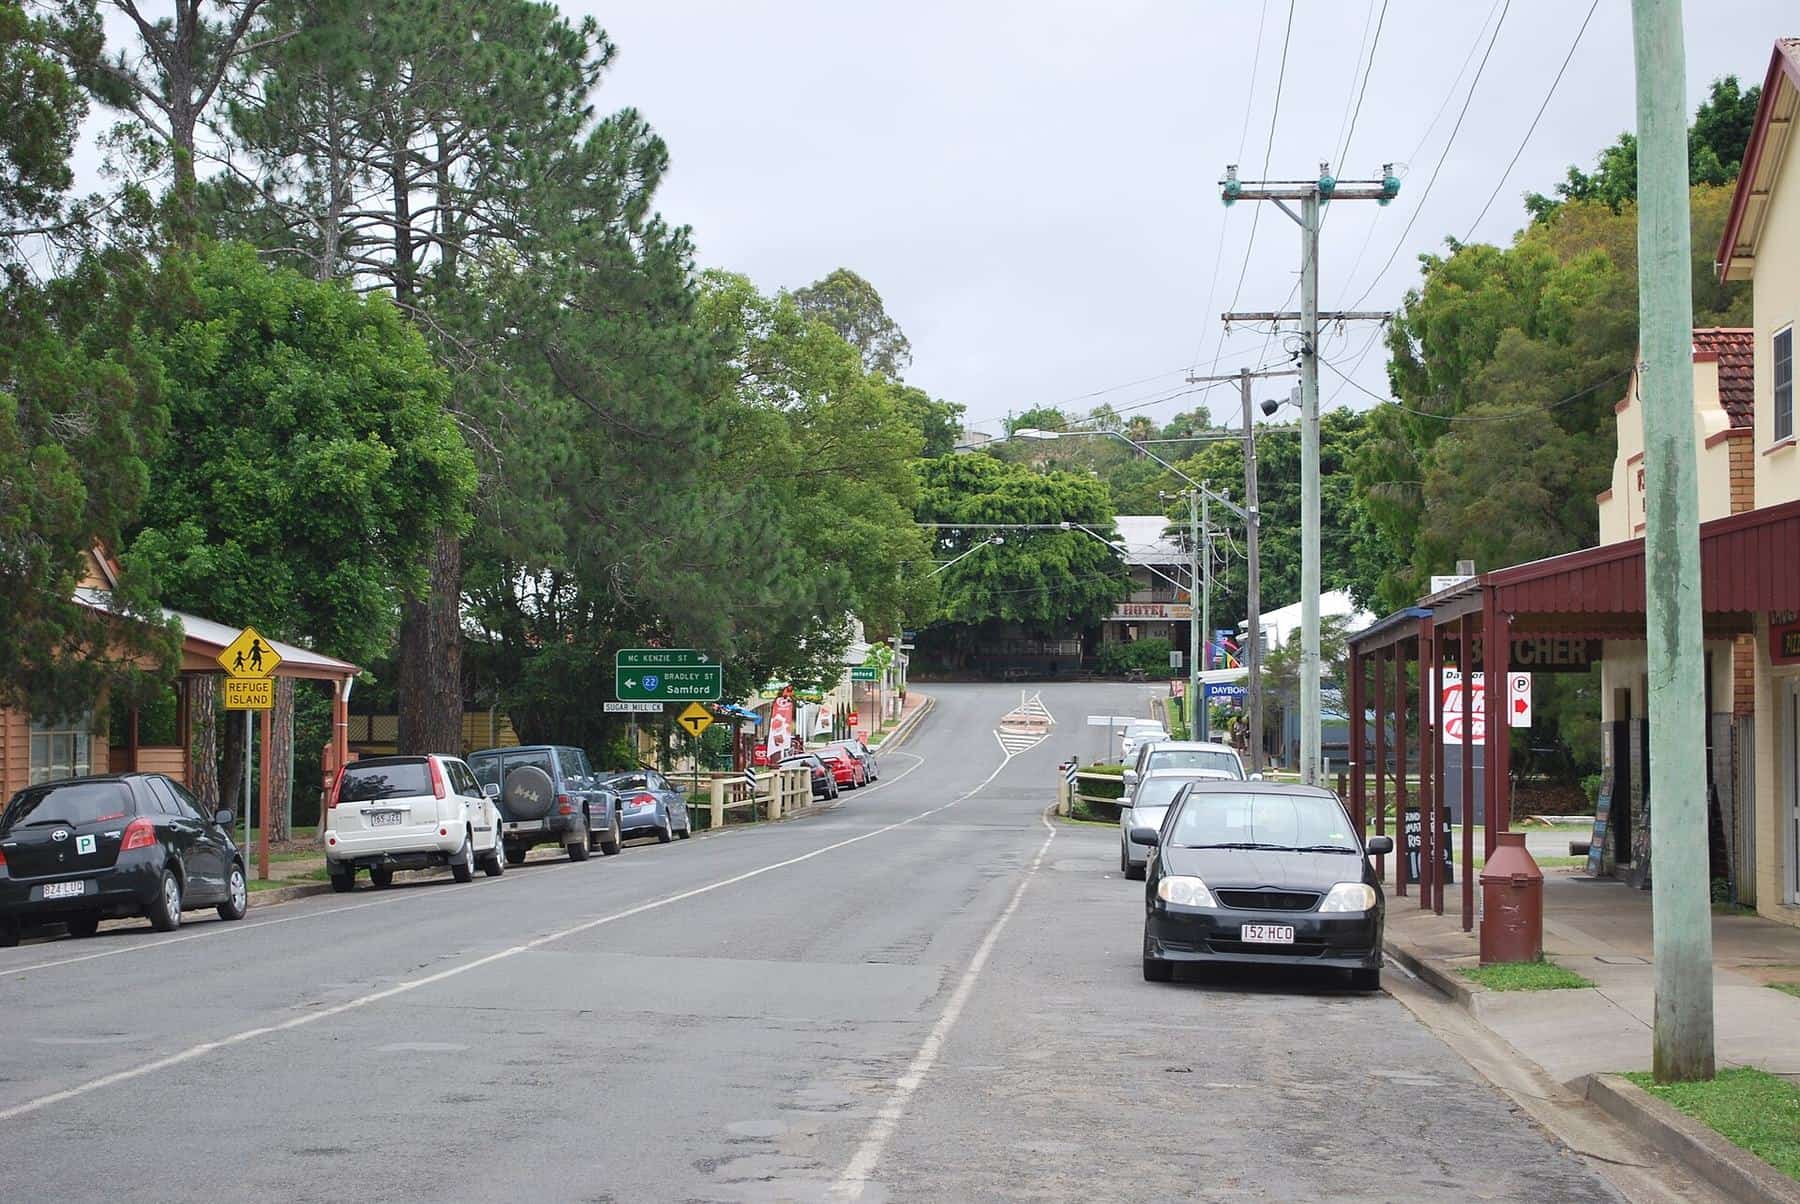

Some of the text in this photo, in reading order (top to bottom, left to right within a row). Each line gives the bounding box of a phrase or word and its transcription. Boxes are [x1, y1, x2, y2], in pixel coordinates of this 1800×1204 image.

[1124, 605, 1168, 617] HOTEL
[645, 678, 656, 687] 22
[1518, 680, 1526, 689] P
[229, 683, 269, 692] REFUGE
[667, 685, 710, 694] Samford
[230, 695, 268, 704] ISLAND
[81, 838, 90, 851] P
[1244, 926, 1264, 938] 152
